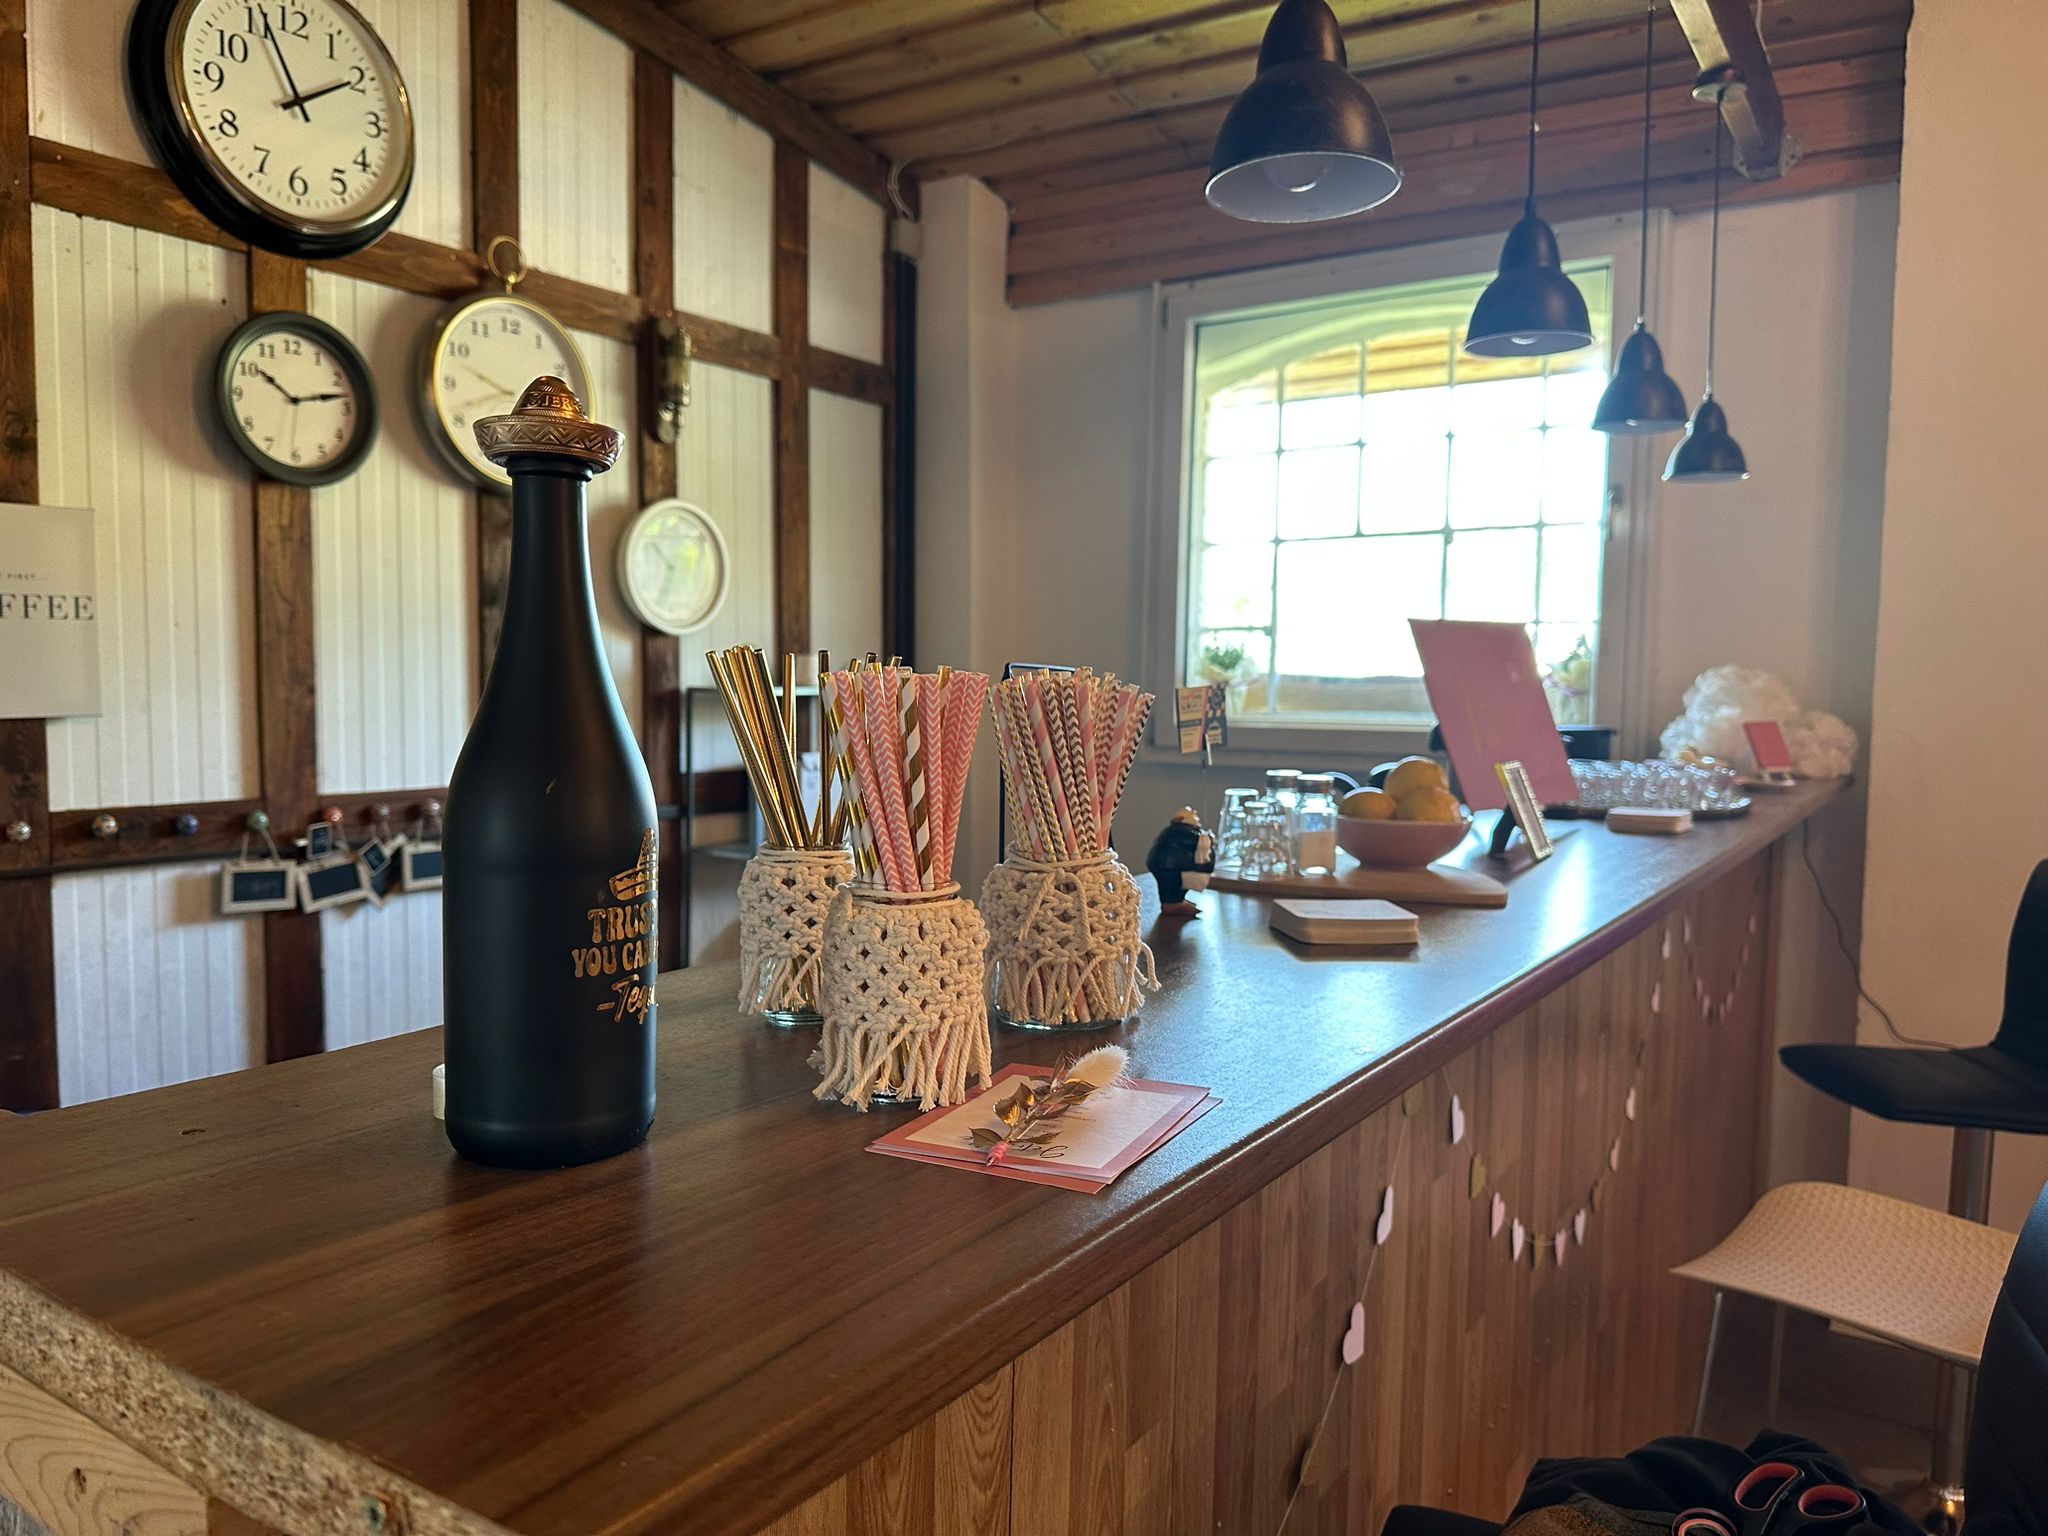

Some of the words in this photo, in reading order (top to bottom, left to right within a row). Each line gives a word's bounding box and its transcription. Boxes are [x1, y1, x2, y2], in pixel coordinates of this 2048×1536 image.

[245, 7, 269, 39] 11
[280, 6, 309, 41] 12
[216, 29, 249, 64] 10
[325, 33, 338, 60] 1
[203, 61, 225, 93] 9
[349, 65, 367, 95] 2
[218, 108, 240, 138] 8
[364, 111, 382, 139] 3
[253, 144, 271, 176] 7
[352, 146, 372, 173] 4
[289, 166, 308, 197] 6
[329, 168, 347, 196] 5
[471, 320, 489, 338] 11
[500, 317, 521, 336] 12
[258, 342, 275, 359] 11
[283, 339, 302, 356] 12
[448, 341, 471, 359] 10
[535, 333, 542, 350] 1
[239, 361, 259, 377] 10
[314, 351, 322, 366] 1
[333, 370, 342, 387] 2
[443, 375, 456, 391] 9
[233, 385, 243, 401] 9
[263, 436, 274, 450] 7
[571, 945, 617, 978] YOU
